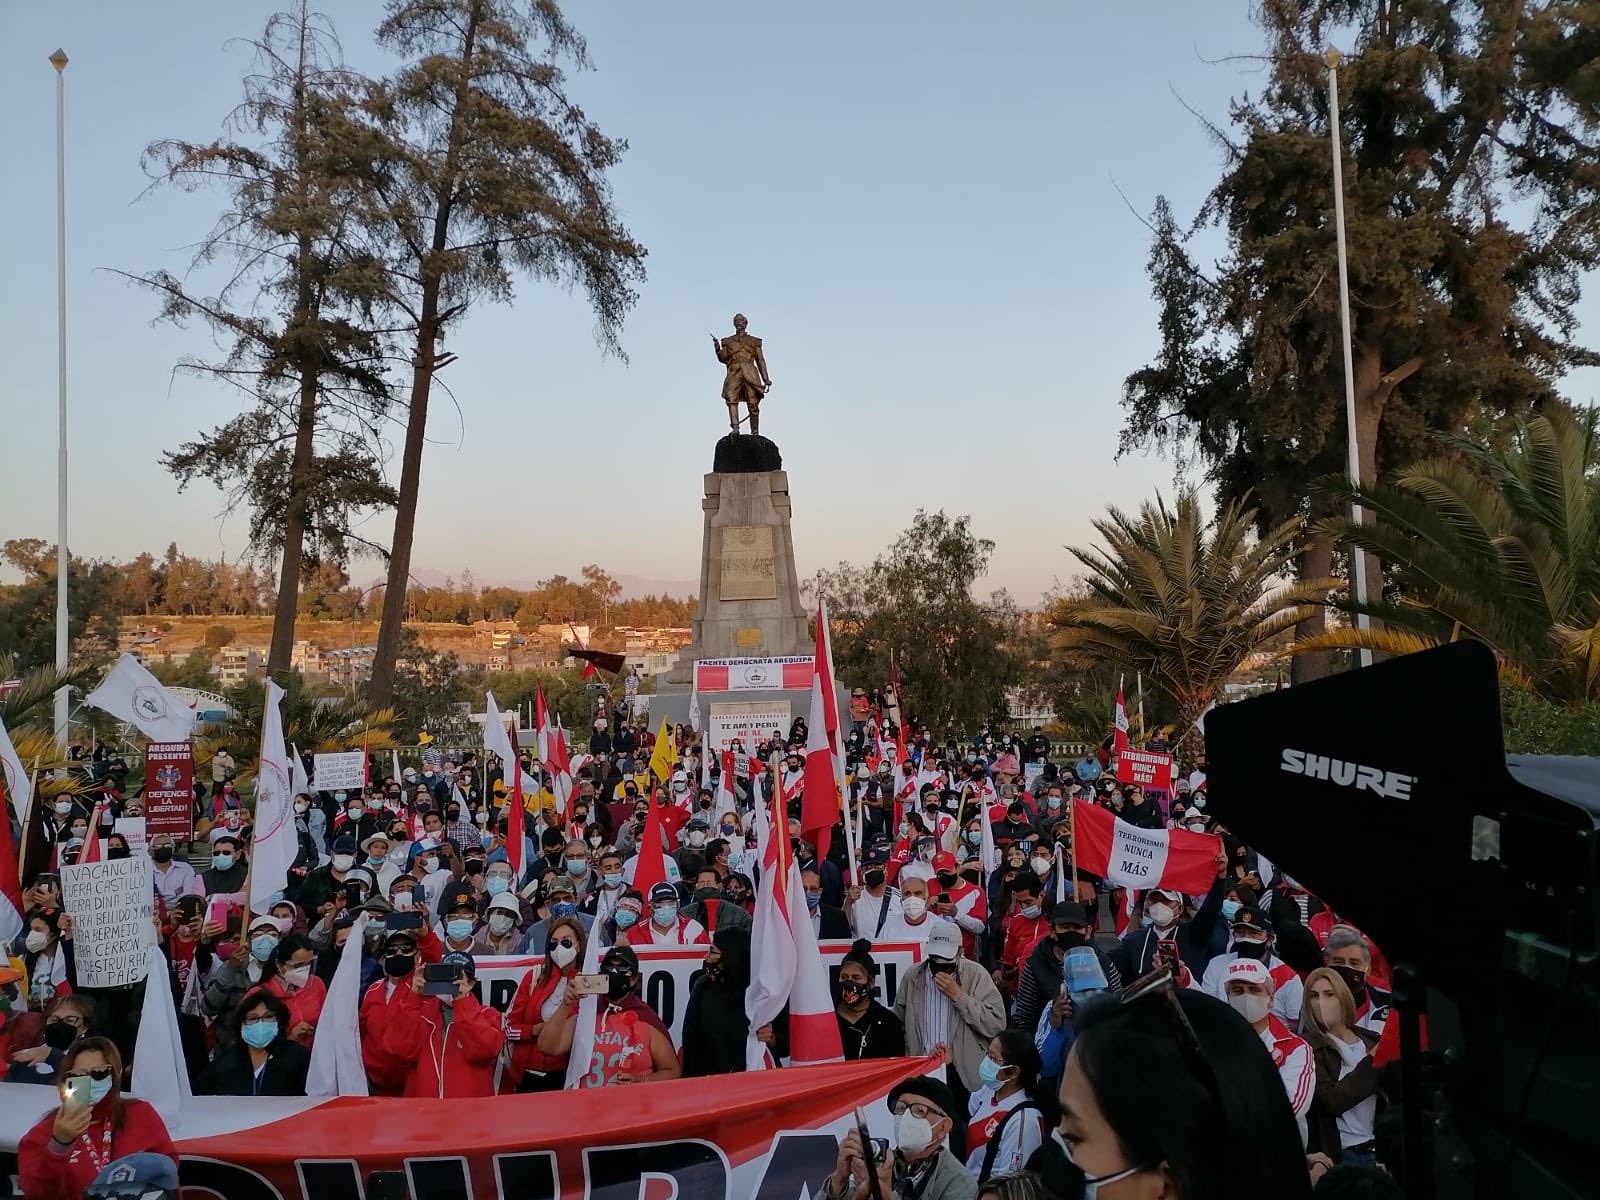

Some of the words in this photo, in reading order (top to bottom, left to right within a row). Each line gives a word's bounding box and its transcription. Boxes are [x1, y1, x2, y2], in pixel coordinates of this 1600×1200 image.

[148, 744, 190, 753] AREQUIPA
[148, 752, 191, 761] PRESENTE!
[1131, 762, 1157, 774] NUNCA
[1281, 748, 1412, 801] SHURE
[148, 790, 189, 798] DEFIENDE
[1118, 830, 1165, 849] TERRORISMO
[1124, 843, 1153, 860] NUNCA
[1120, 860, 1149, 877] MÁS
[64, 881, 92, 898] FUERA
[95, 875, 145, 894] CASTILLO
[65, 898, 91, 914] FUERA
[94, 894, 120, 911] DINA
[125, 891, 142, 906] BOL
[96, 909, 131, 927] BELLIDO
[133, 906, 138, 920] Y
[93, 922, 139, 944] BERMEJO
[87, 972, 99, 985] MI
